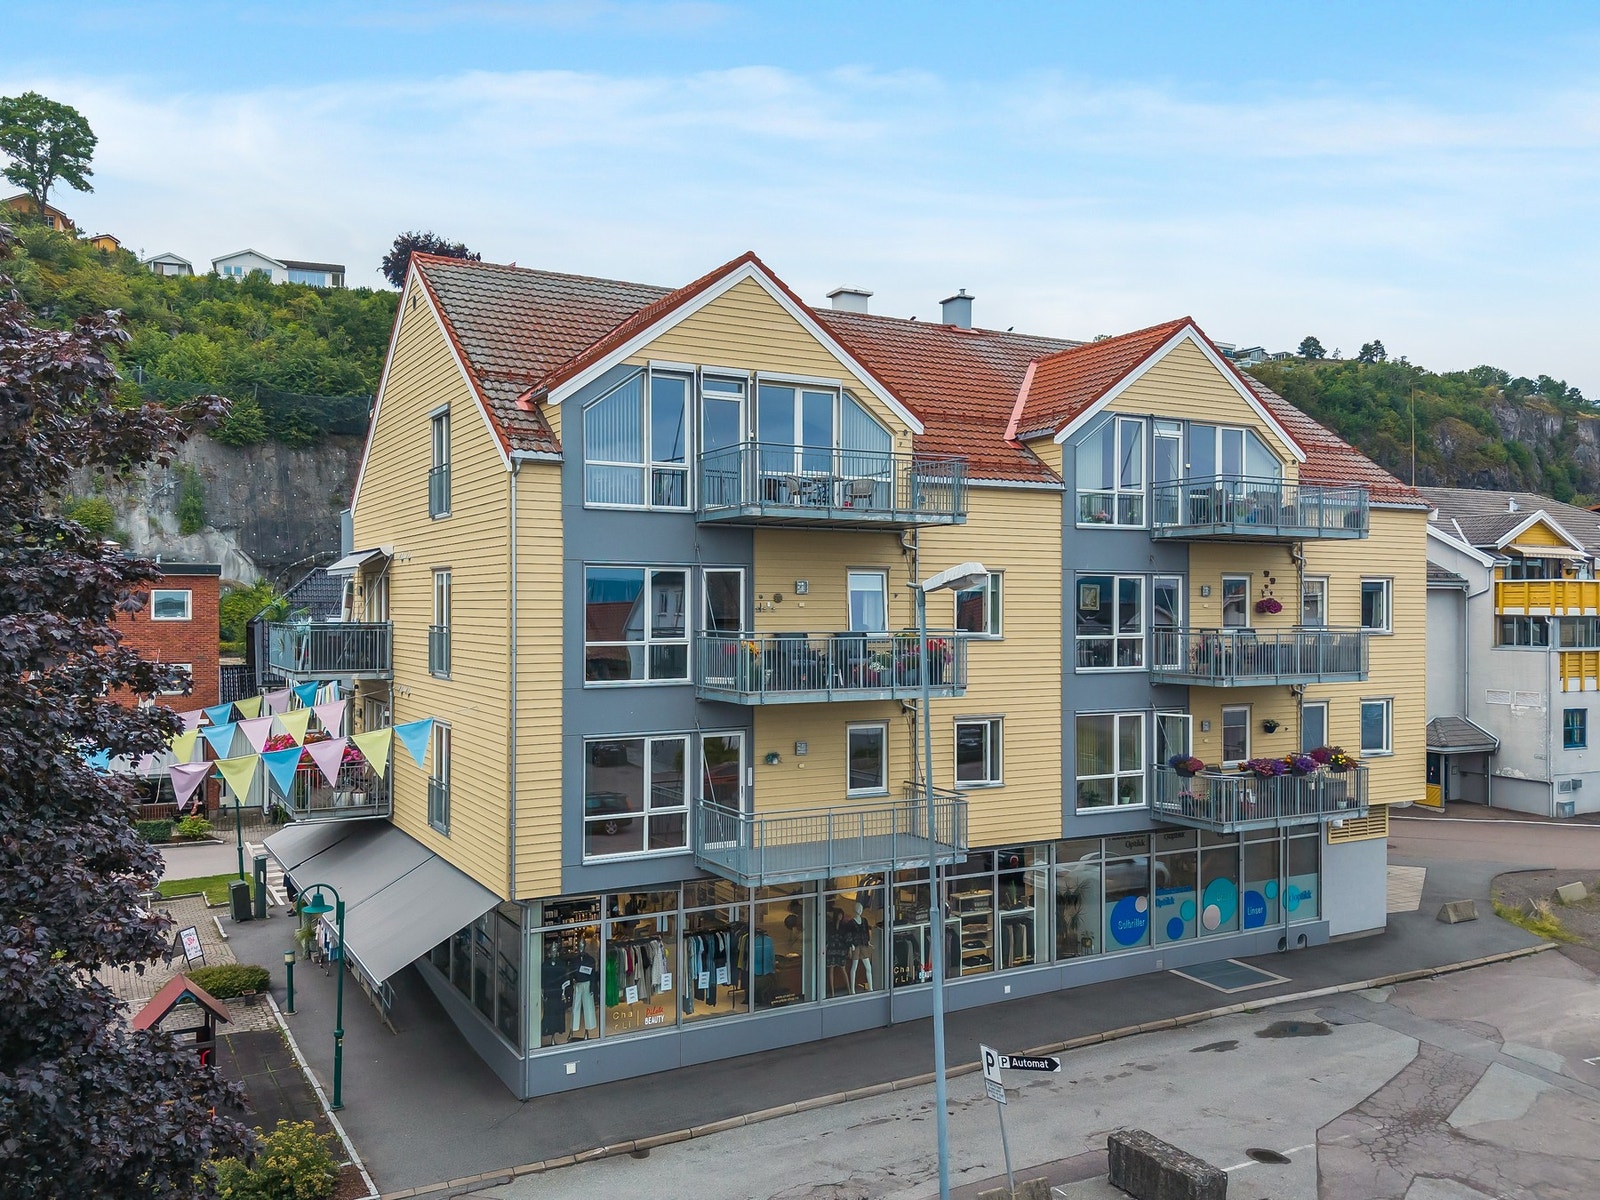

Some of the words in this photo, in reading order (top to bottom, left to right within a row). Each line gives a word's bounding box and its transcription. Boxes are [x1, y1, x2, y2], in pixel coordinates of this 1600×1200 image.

[1247, 907, 1264, 916] Linser
[1118, 918, 1146, 930] Solbriller
[644, 1014, 665, 1025] BEAUTY
[986, 1051, 995, 1075] P
[1001, 1057, 1008, 1067] P
[1012, 1058, 1049, 1069] Automat
